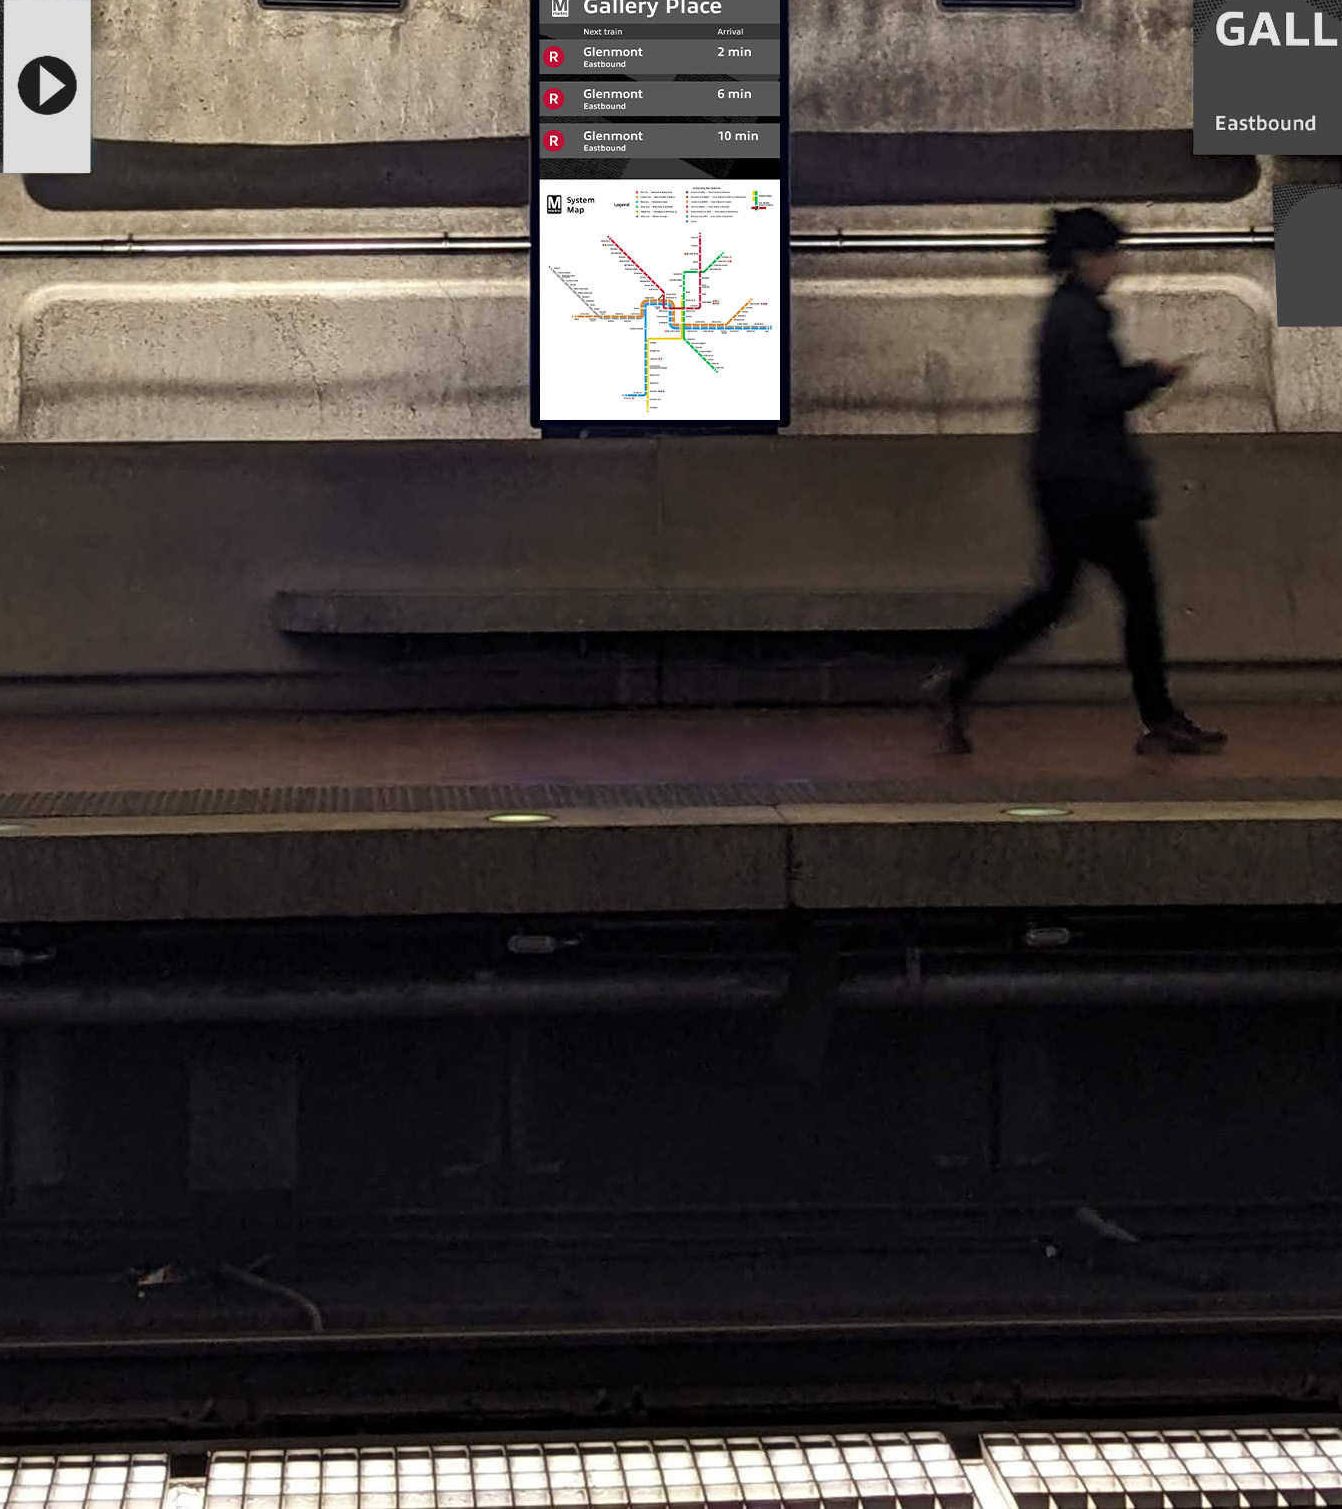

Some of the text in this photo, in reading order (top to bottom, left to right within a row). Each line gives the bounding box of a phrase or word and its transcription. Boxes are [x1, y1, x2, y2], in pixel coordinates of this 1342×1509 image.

[584, 47, 643, 56] Glenmont
[718, 47, 751, 56] 2 min
[550, 51, 558, 62] R
[584, 89, 643, 98] Glenmont
[718, 89, 751, 98] 6 min
[550, 93, 558, 104] R
[1216, 115, 1315, 131] Eastbound
[584, 131, 643, 140] Glenmont
[718, 131, 758, 140] 10 min
[550, 135, 558, 146] R
[567, 197, 594, 205] System
